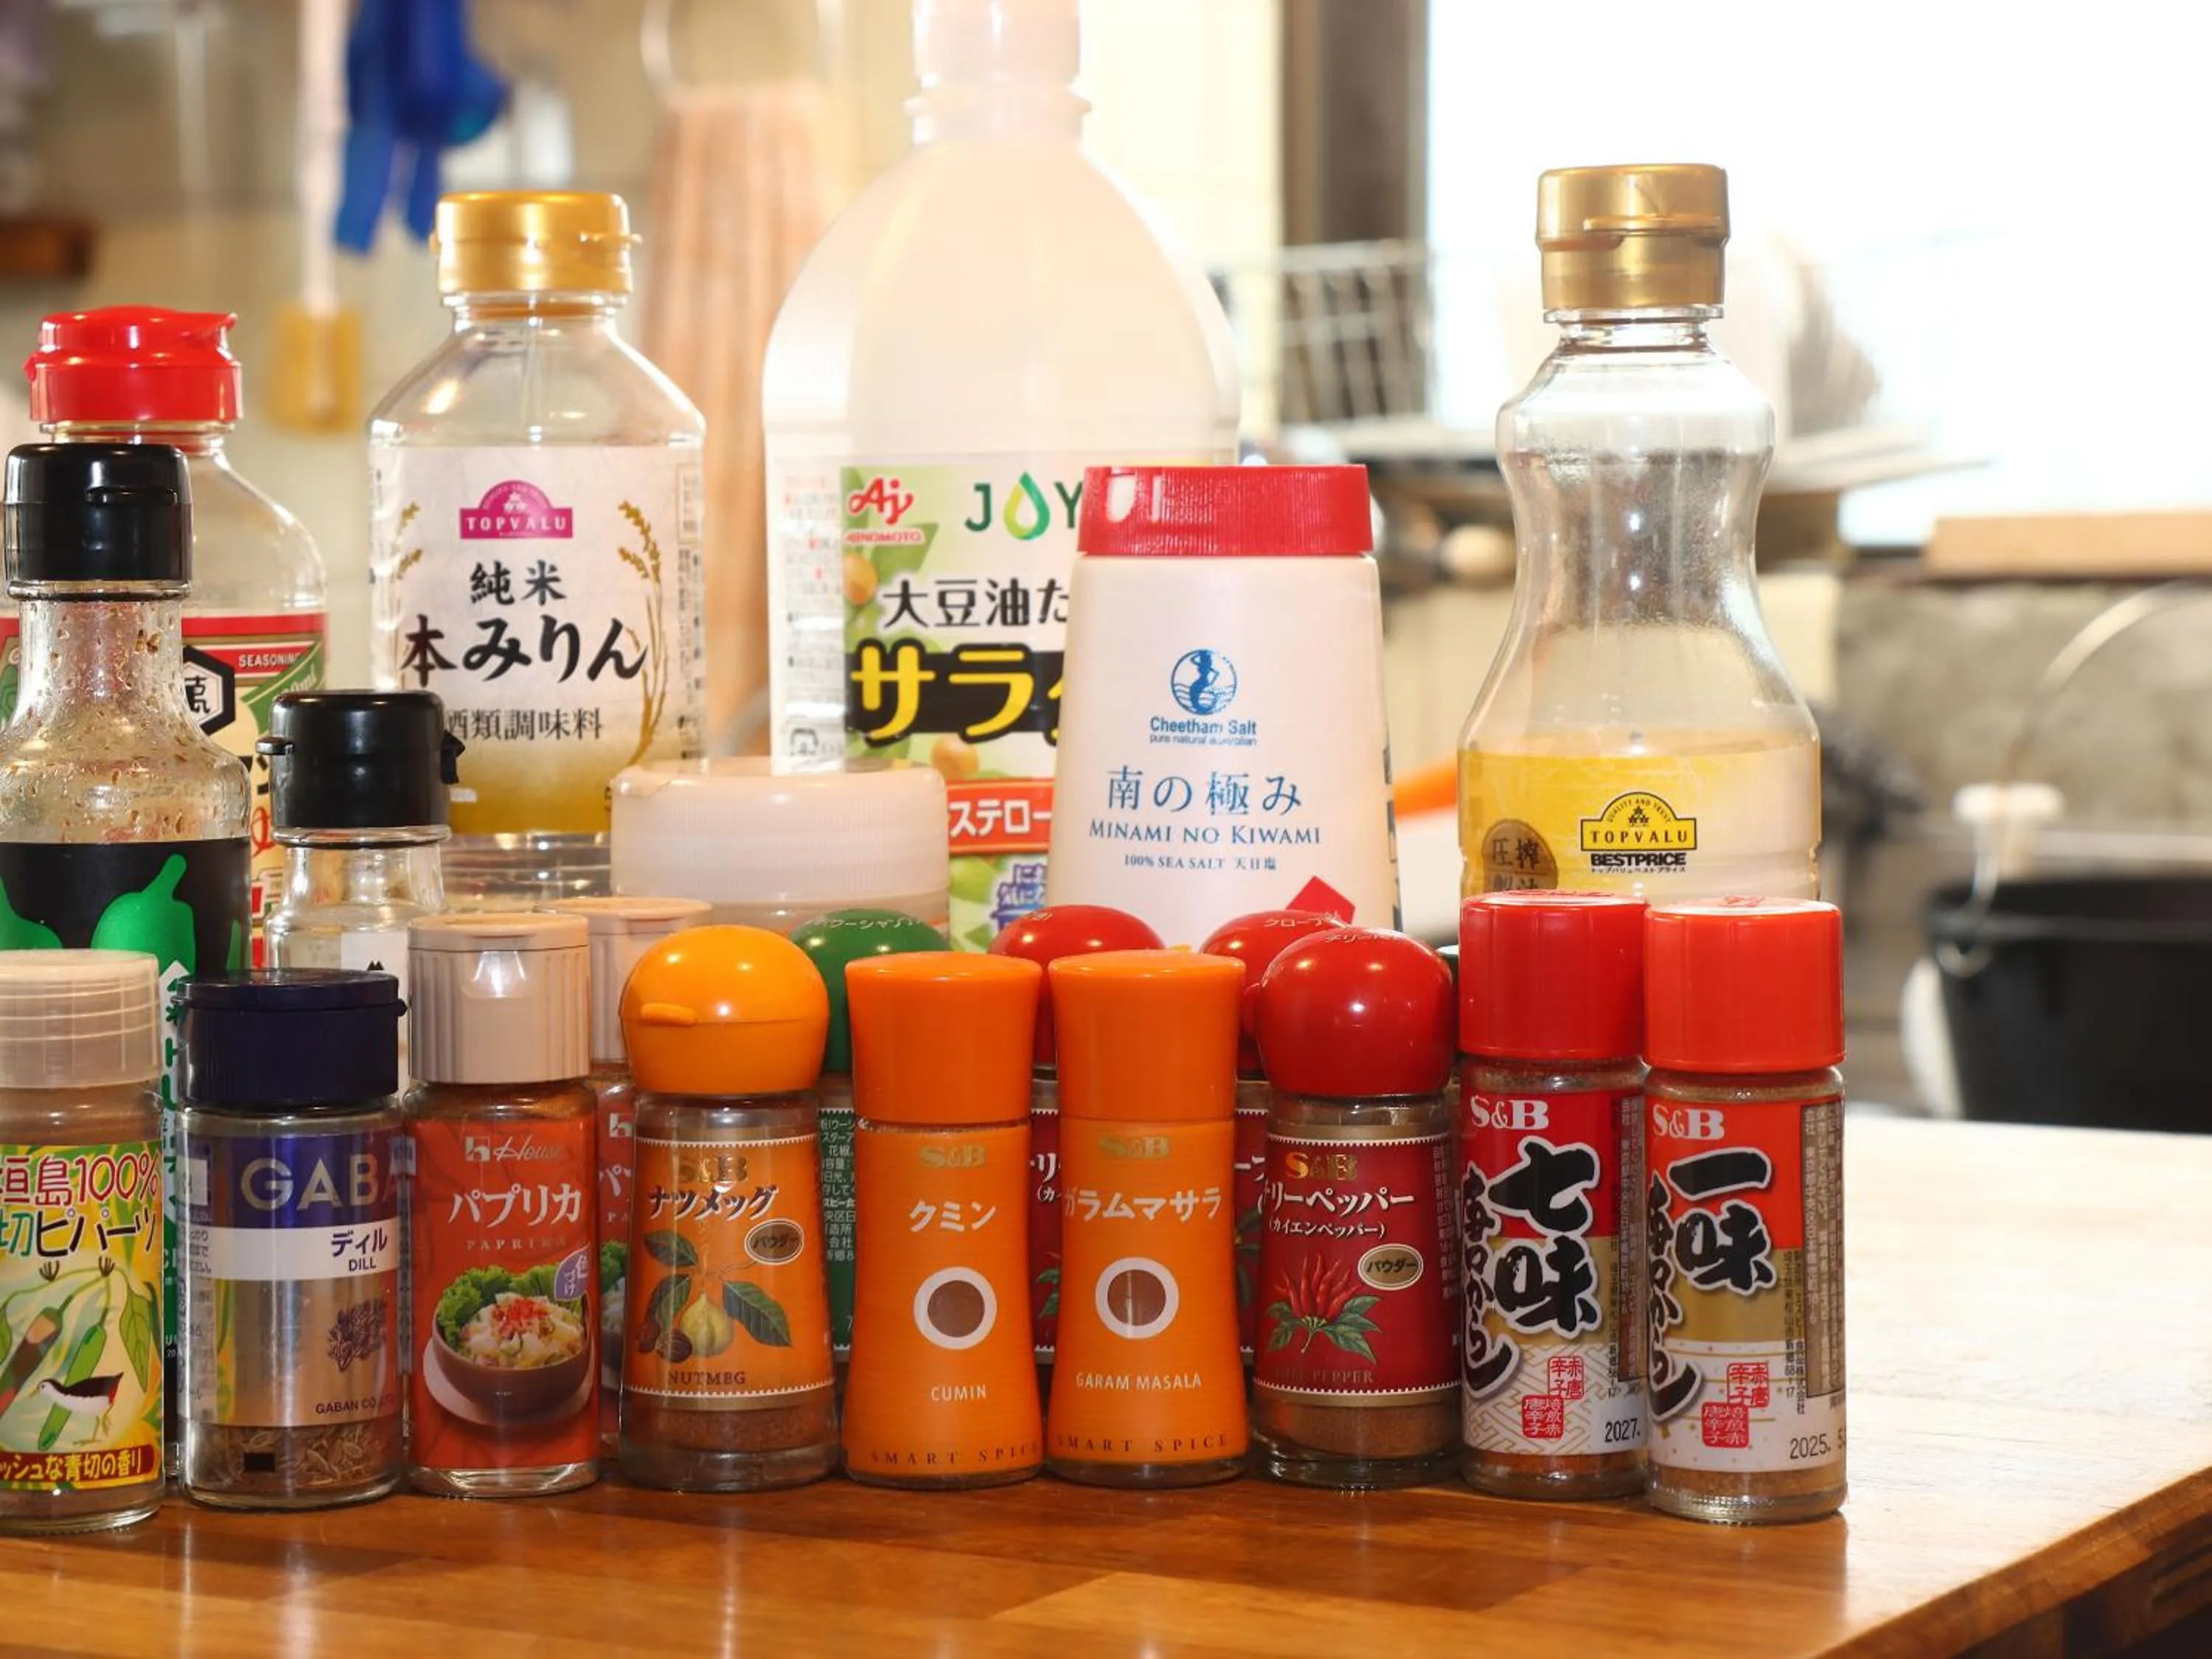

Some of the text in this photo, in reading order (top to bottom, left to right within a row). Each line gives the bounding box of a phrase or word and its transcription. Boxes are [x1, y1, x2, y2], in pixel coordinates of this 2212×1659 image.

[466, 516, 567, 532] TOPVALU
[470, 560, 566, 606] 純米
[400, 614, 648, 687] 本みりん
[852, 644, 1062, 740] サラ
[448, 708, 602, 740] 酒類調味料
[1150, 716, 1257, 735] Cheetham Salt
[1107, 765, 1302, 817] 南の極み
[1635, 798, 1651, 806] AND
[949, 799, 1052, 838] ステロー
[1089, 820, 1321, 845] MINAMI NO KIWAMI
[1590, 830, 1688, 844] TOPVALU
[1124, 854, 1224, 870] 100% SEA SALT
[1590, 852, 1686, 866] BESTPRICE
[1470, 1096, 1548, 1130] S&B
[1653, 1107, 1725, 1139] S&B
[448, 1183, 581, 1228] パプリカ
[649, 1184, 779, 1221] ナツメッグ
[1065, 1186, 1222, 1222] ガラムマサラ
[908, 1200, 996, 1233] クミン
[1669, 1149, 1774, 1292] 一味
[331, 1227, 388, 1258] ディル
[466, 1237, 568, 1251] PAPRIKA
[1488, 1138, 1599, 1338] 七味
[349, 1257, 377, 1272] DILL
[668, 1371, 746, 1386] NUTMEG
[1076, 1371, 1202, 1390] GARAM MASALA
[931, 1384, 987, 1402] CUMIN
[315, 1399, 358, 1414] GABAN
[1604, 1417, 1641, 1443] 2027.
[1057, 1434, 1133, 1453] SMART
[871, 1449, 959, 1465] SMART
